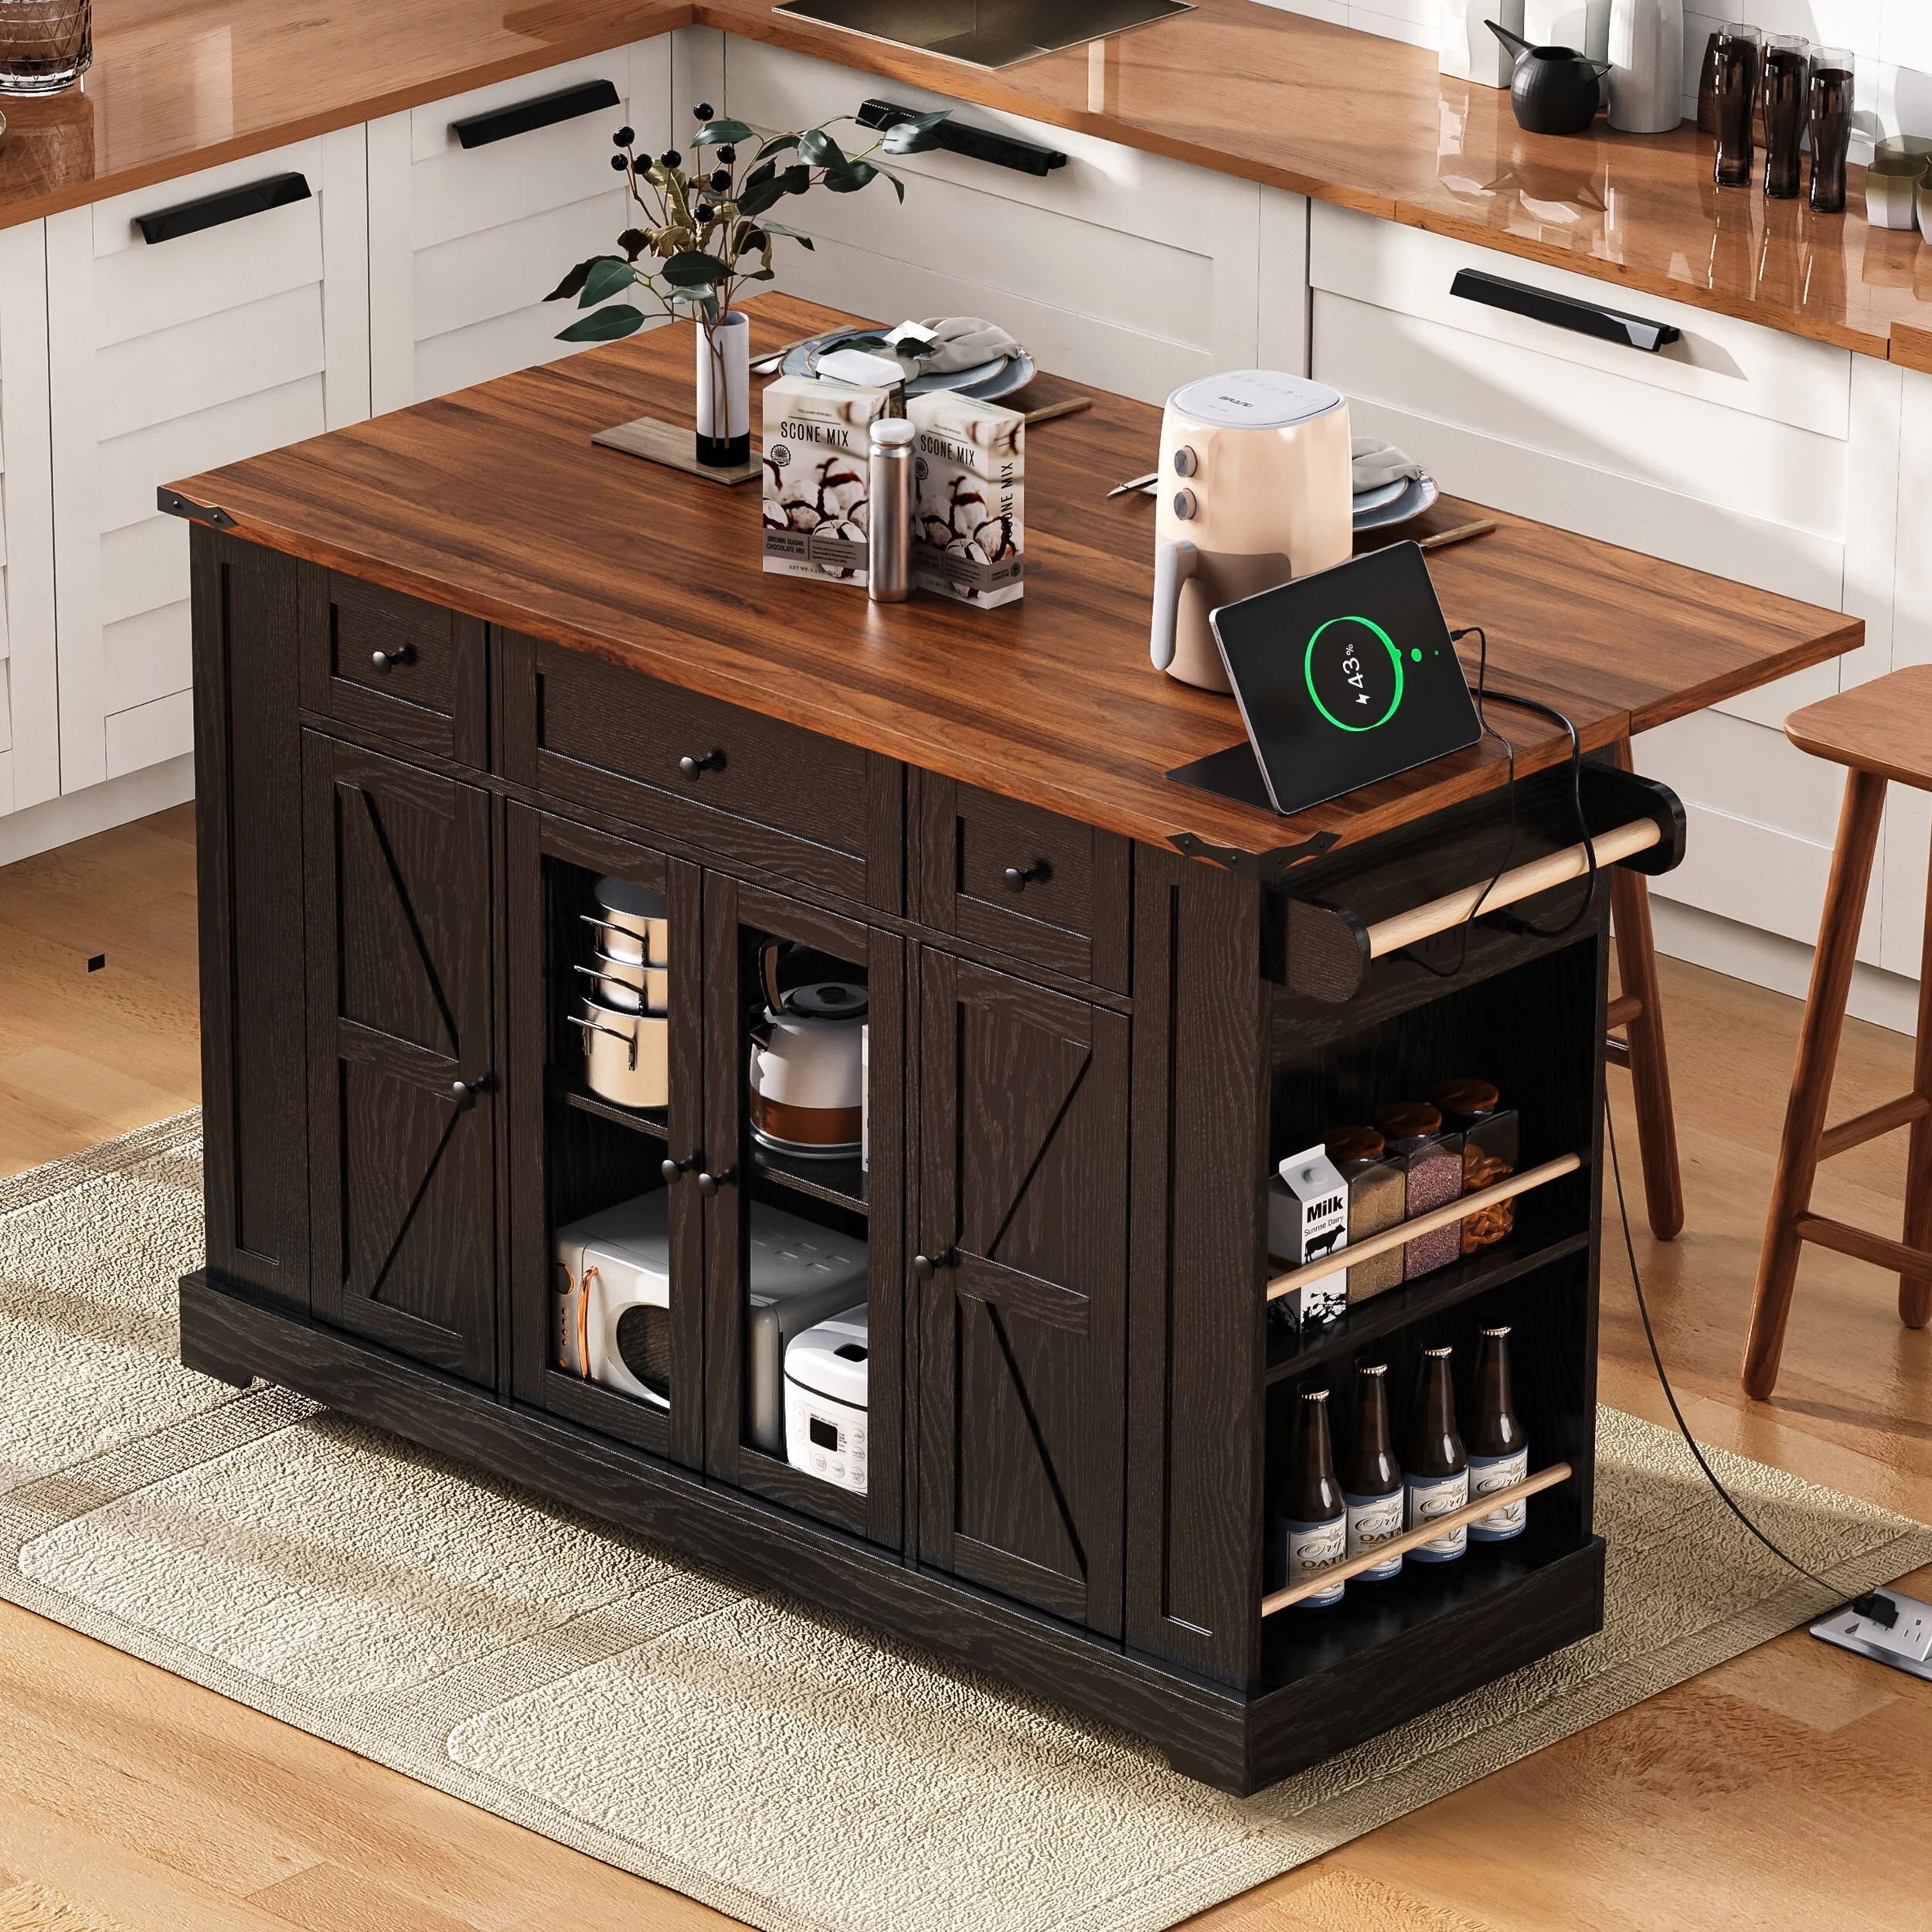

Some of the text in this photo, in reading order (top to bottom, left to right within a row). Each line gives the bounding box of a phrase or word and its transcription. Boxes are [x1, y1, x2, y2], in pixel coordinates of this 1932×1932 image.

[781, 421, 849, 447] SCONE MIX
[920, 434, 975, 467] SCONE MIX
[1001, 462, 1013, 489] MIX
[766, 543, 794, 553] CHOCOLATE
[767, 535, 786, 544] BROWN
[787, 538, 804, 547] SUGAR
[1307, 1196, 1344, 1223] Milk
[1304, 1215, 1344, 1236] Sunrise Dairy
[1420, 1492, 1467, 1515] Org
[1355, 1511, 1402, 1533] Org
[1297, 1536, 1344, 1560] Org
